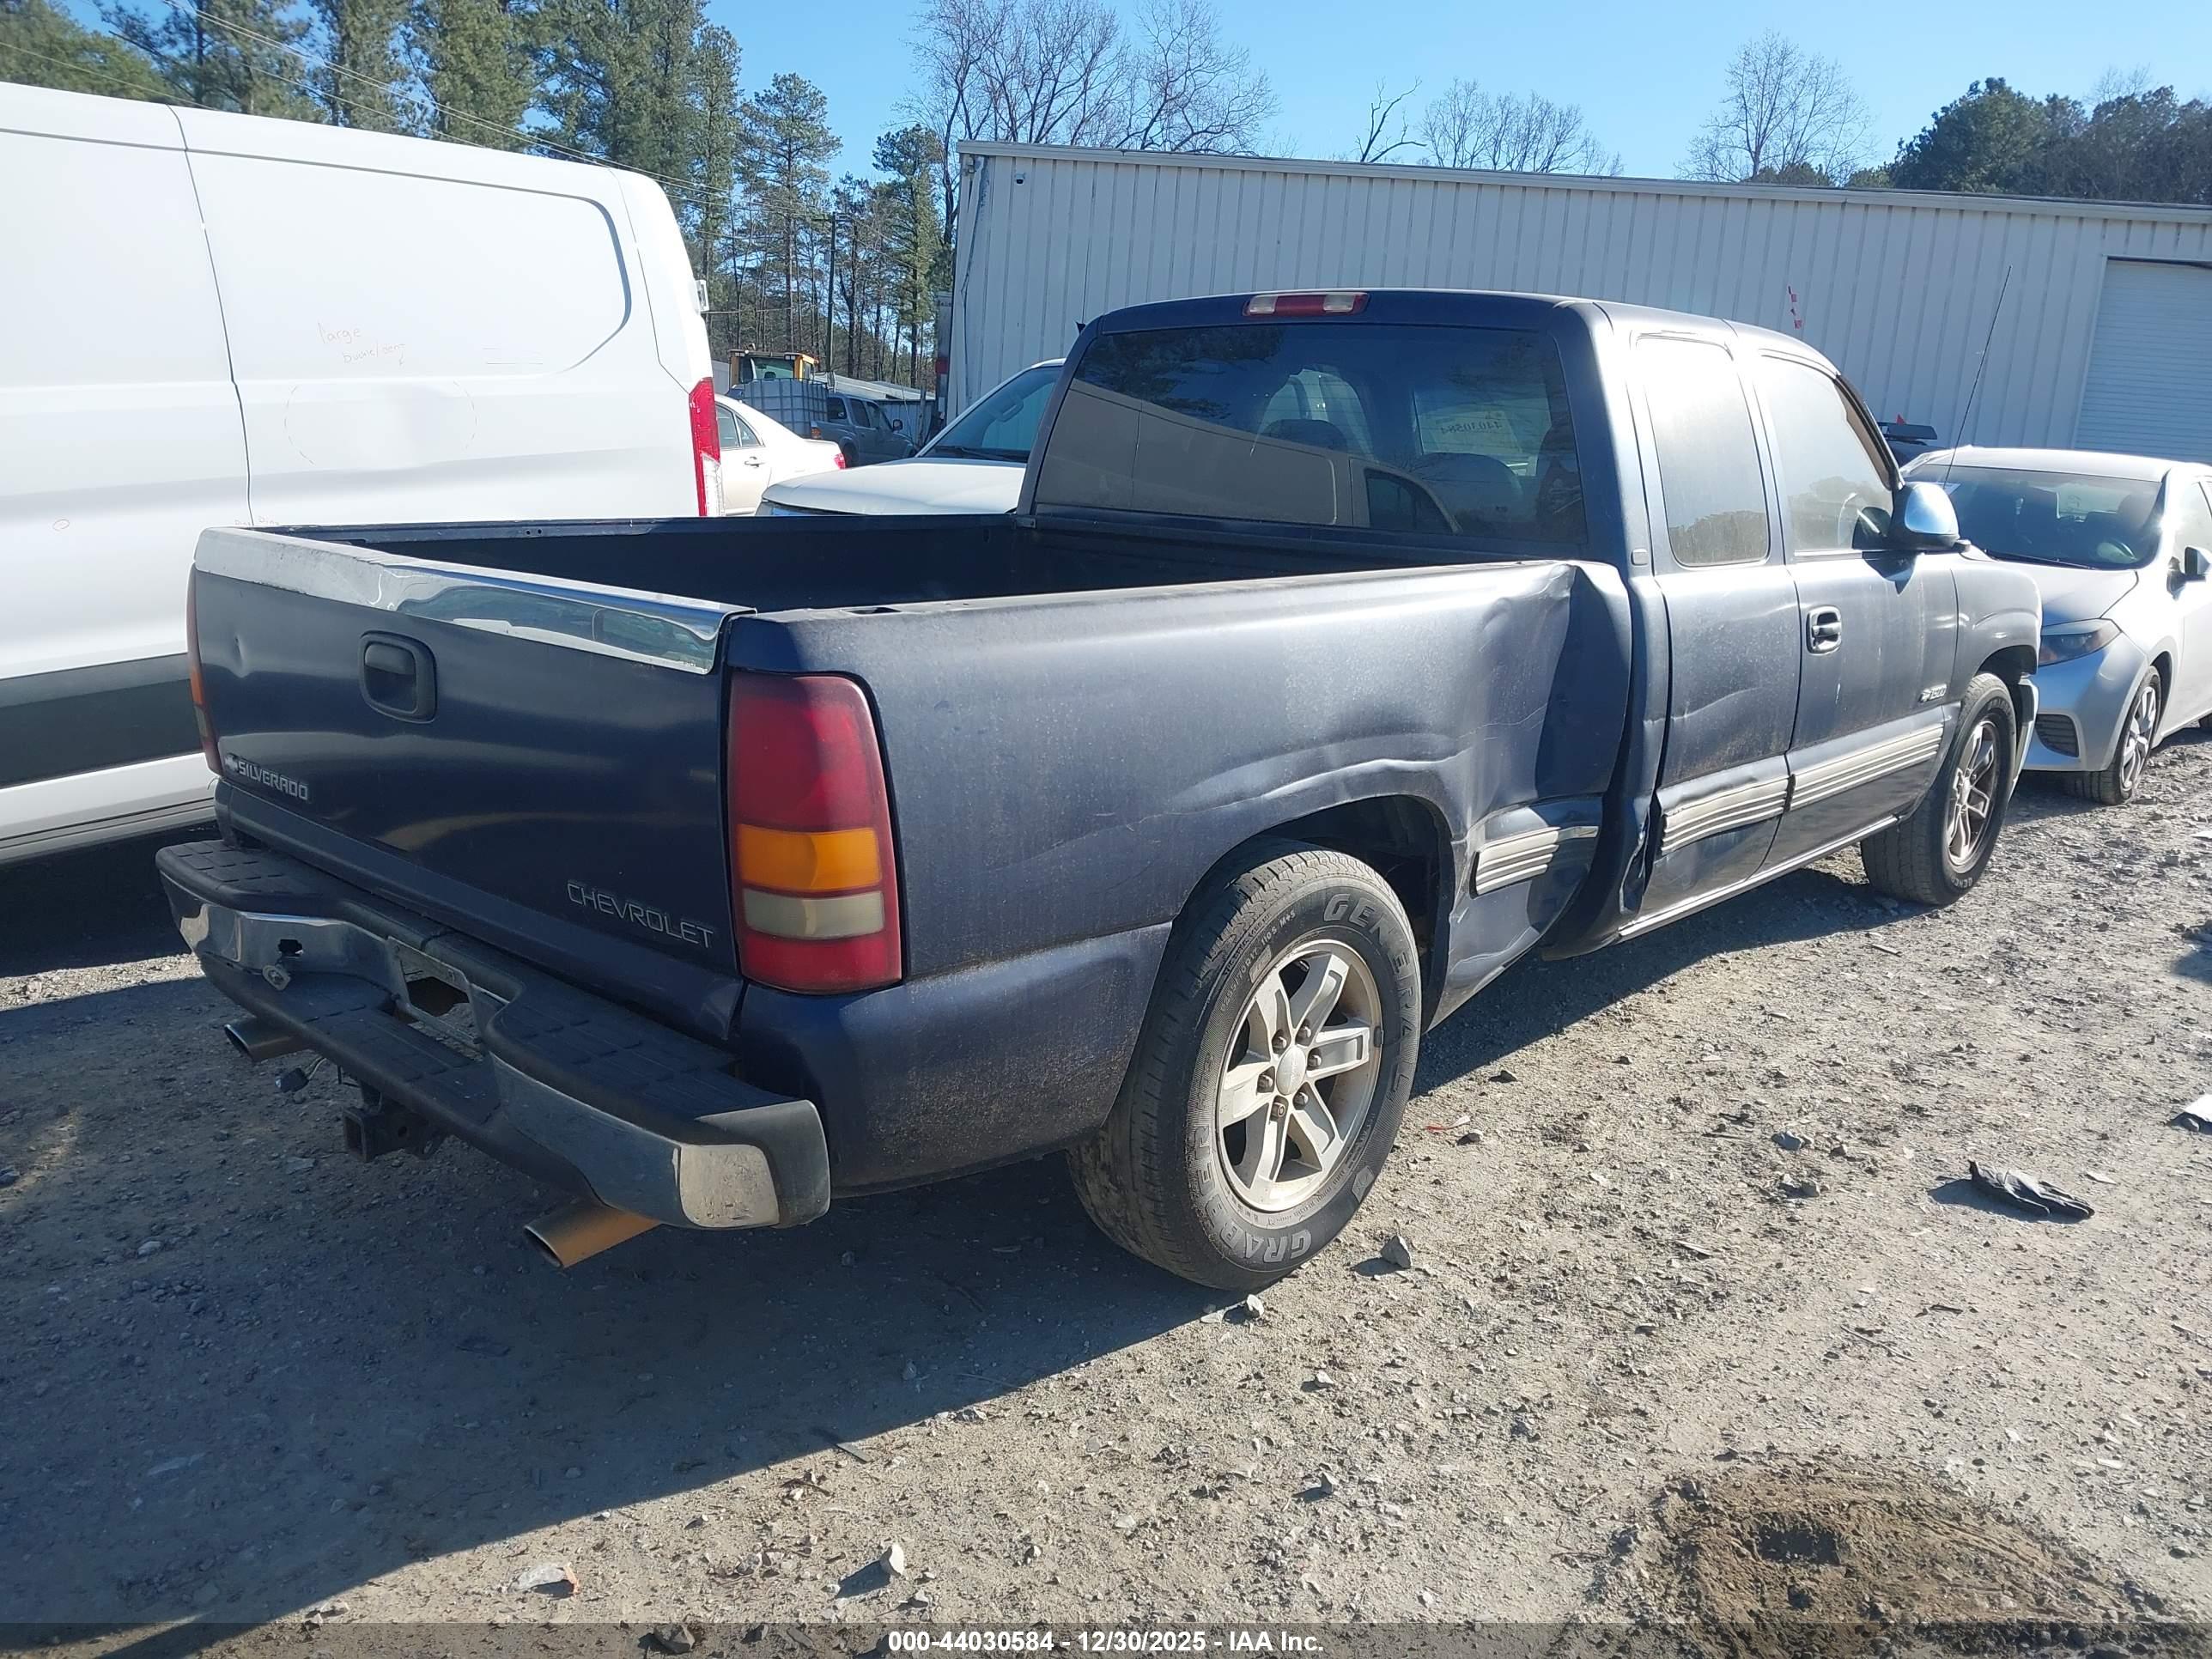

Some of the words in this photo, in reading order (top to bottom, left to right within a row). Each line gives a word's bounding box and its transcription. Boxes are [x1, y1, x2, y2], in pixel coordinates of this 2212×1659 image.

[238, 760, 308, 800] SILVERADO
[567, 883, 714, 948] CHEVROLET
[1323, 893, 1417, 1094] GENERAL
[1194, 1125, 1312, 1263] GRABBER
